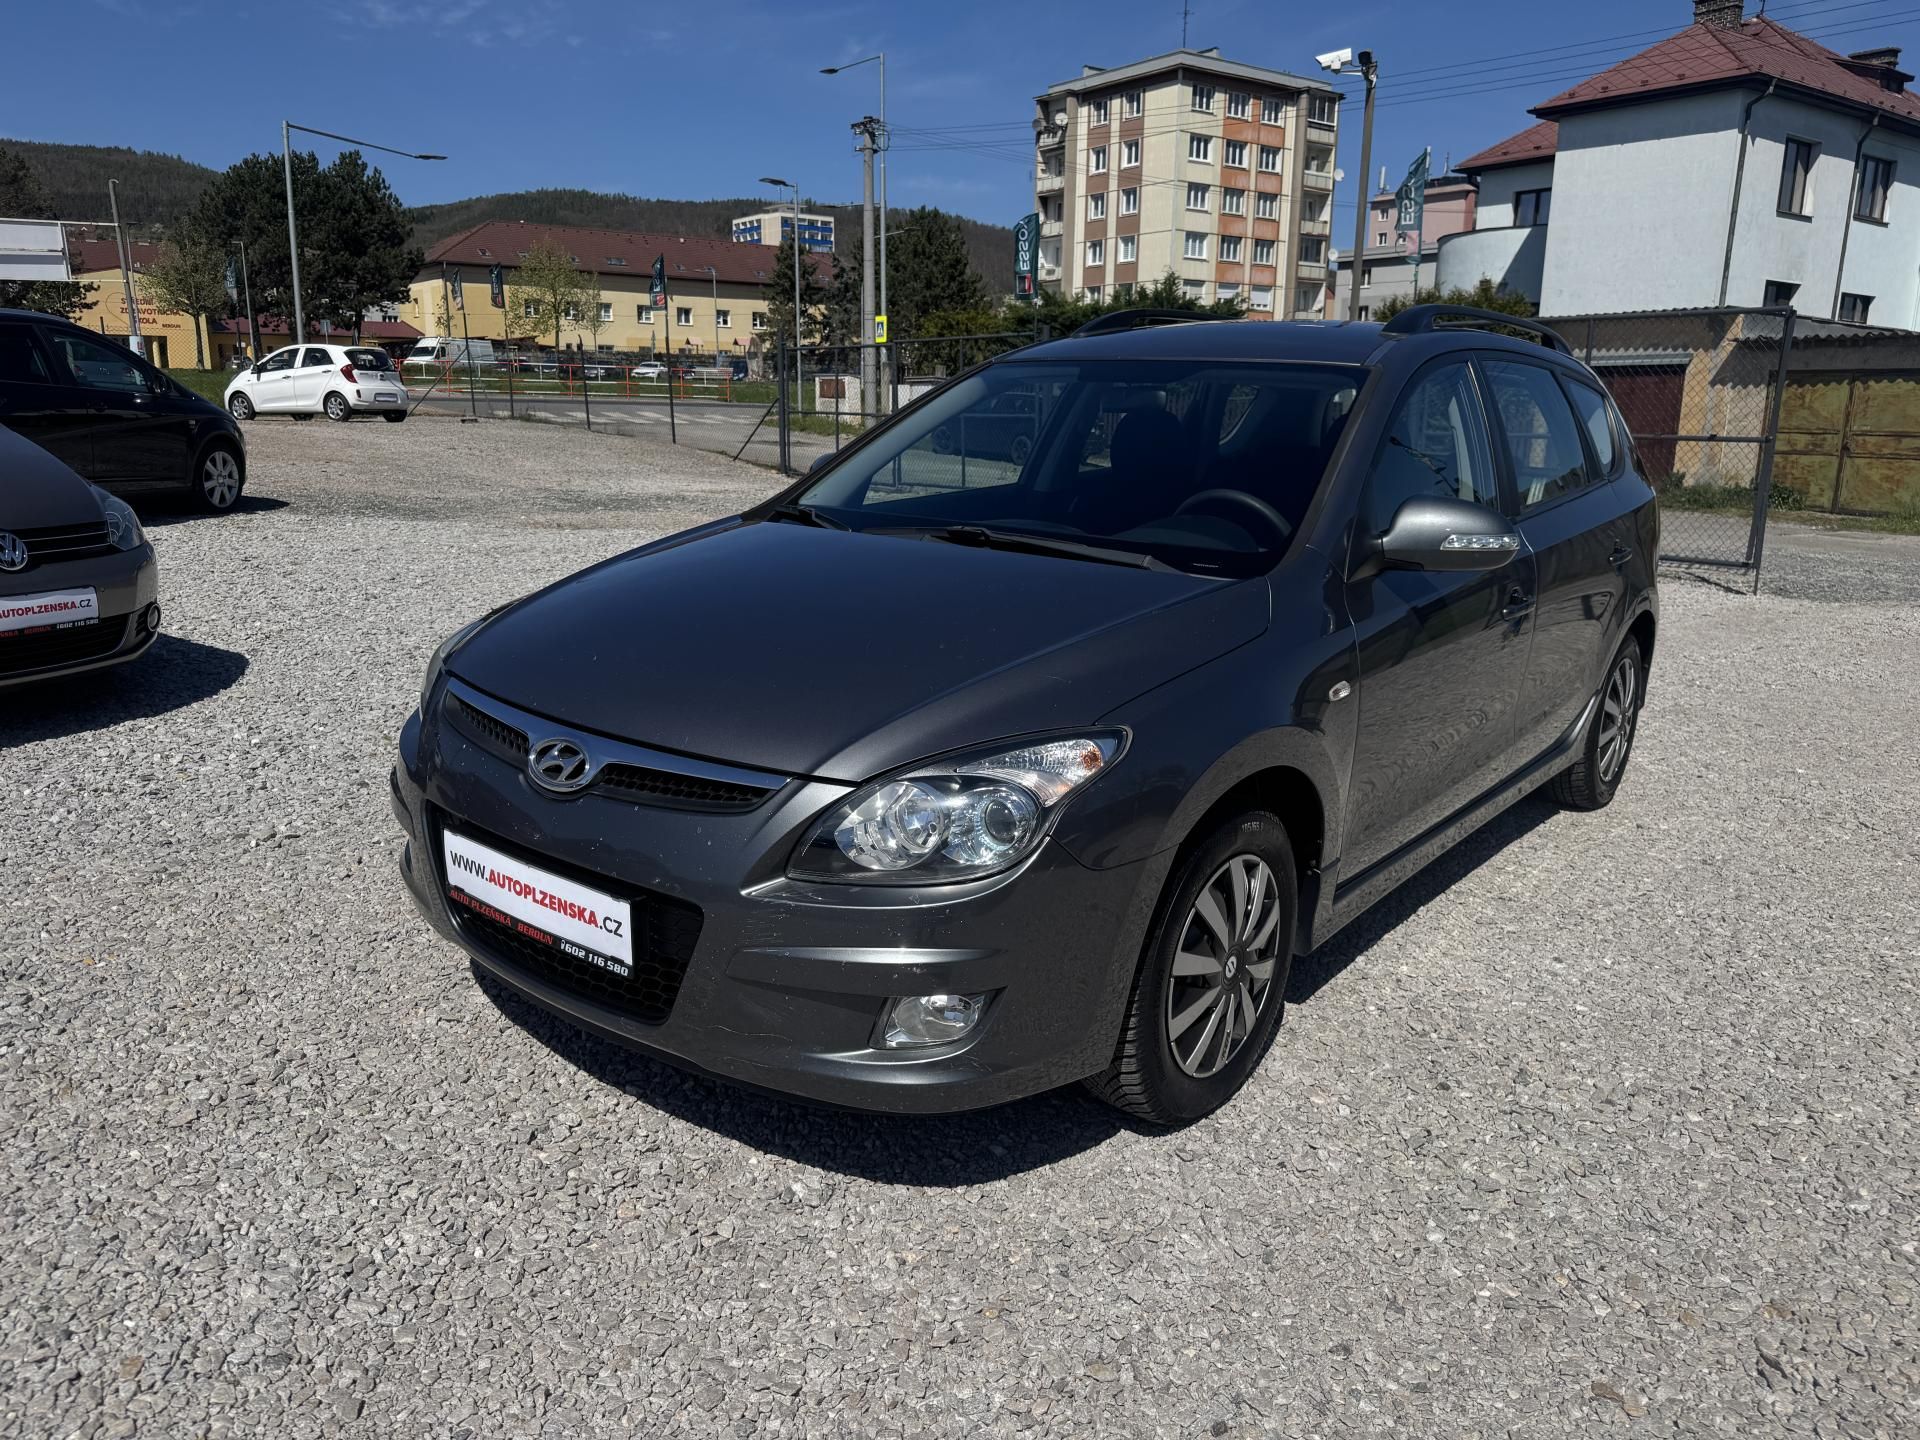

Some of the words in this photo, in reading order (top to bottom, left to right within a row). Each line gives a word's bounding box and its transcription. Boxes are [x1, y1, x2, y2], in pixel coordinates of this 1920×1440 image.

[449, 889, 469, 905] AUTO
[518, 922, 553, 945] BEROUN
[565, 943, 586, 959] 602
[588, 953, 606, 967] 116
[607, 960, 629, 977] 580
[450, 850, 623, 938] WWW.AUTOPLZENSKA.CZ
